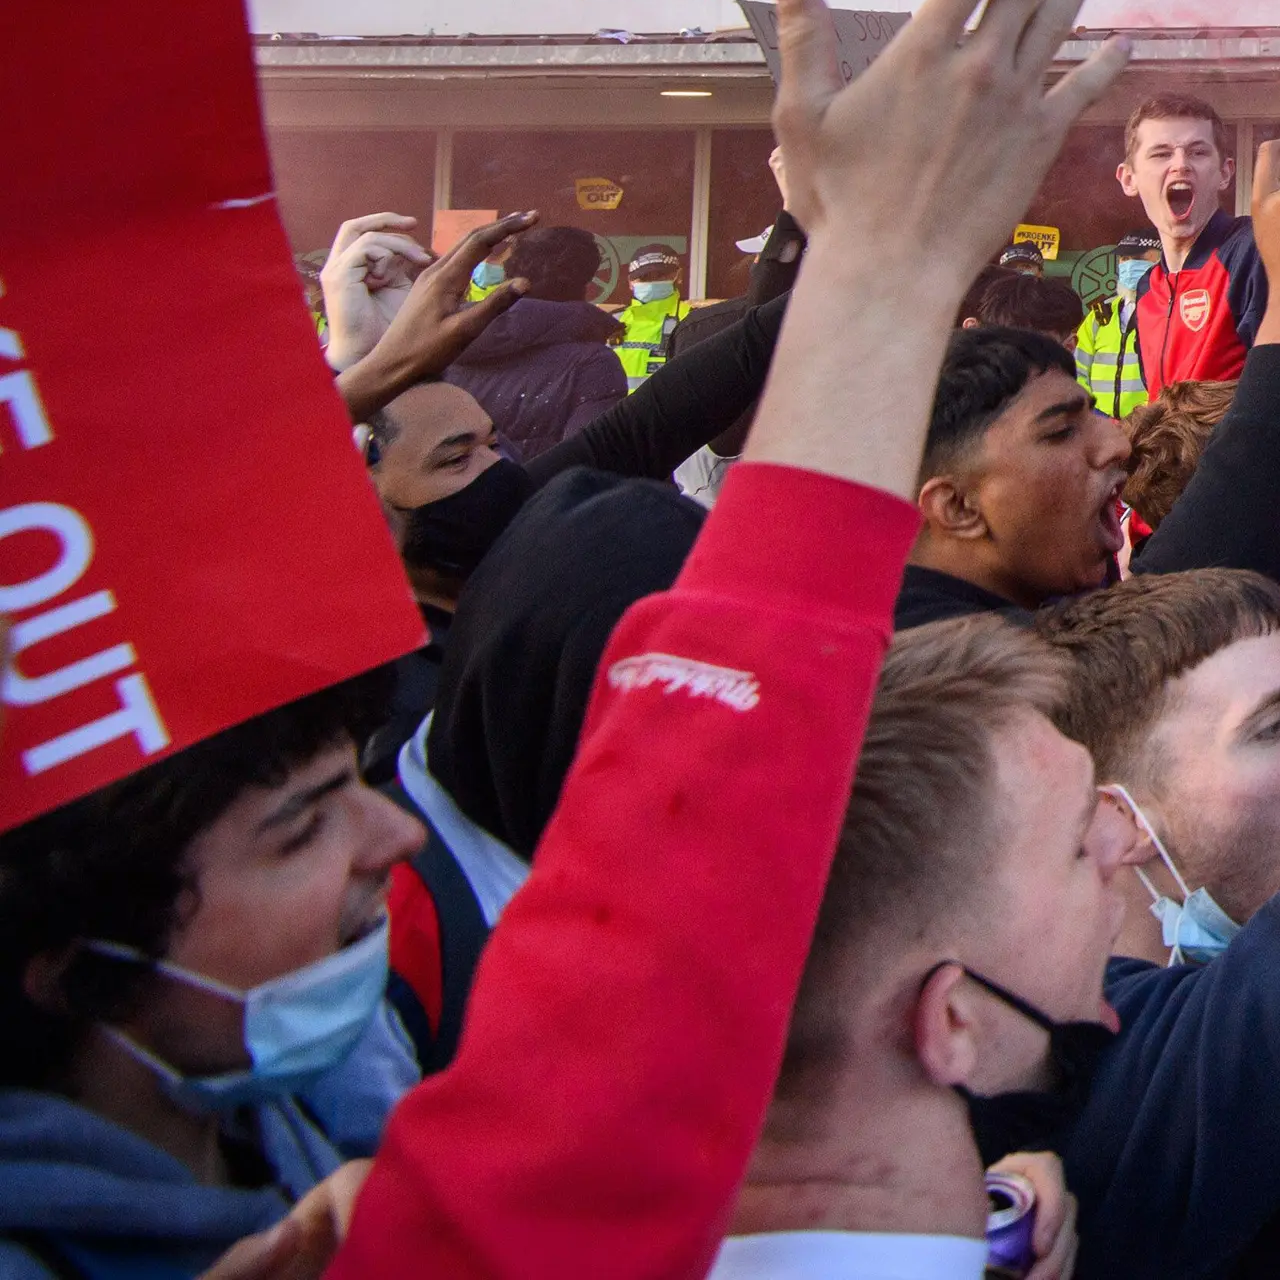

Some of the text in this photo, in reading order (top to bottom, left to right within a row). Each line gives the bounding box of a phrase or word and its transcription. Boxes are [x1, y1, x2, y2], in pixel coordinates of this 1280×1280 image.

[587, 192, 619, 204] OUT
[1016, 231, 1057, 240] #KROENKE
[1035, 240, 1055, 252] UT
